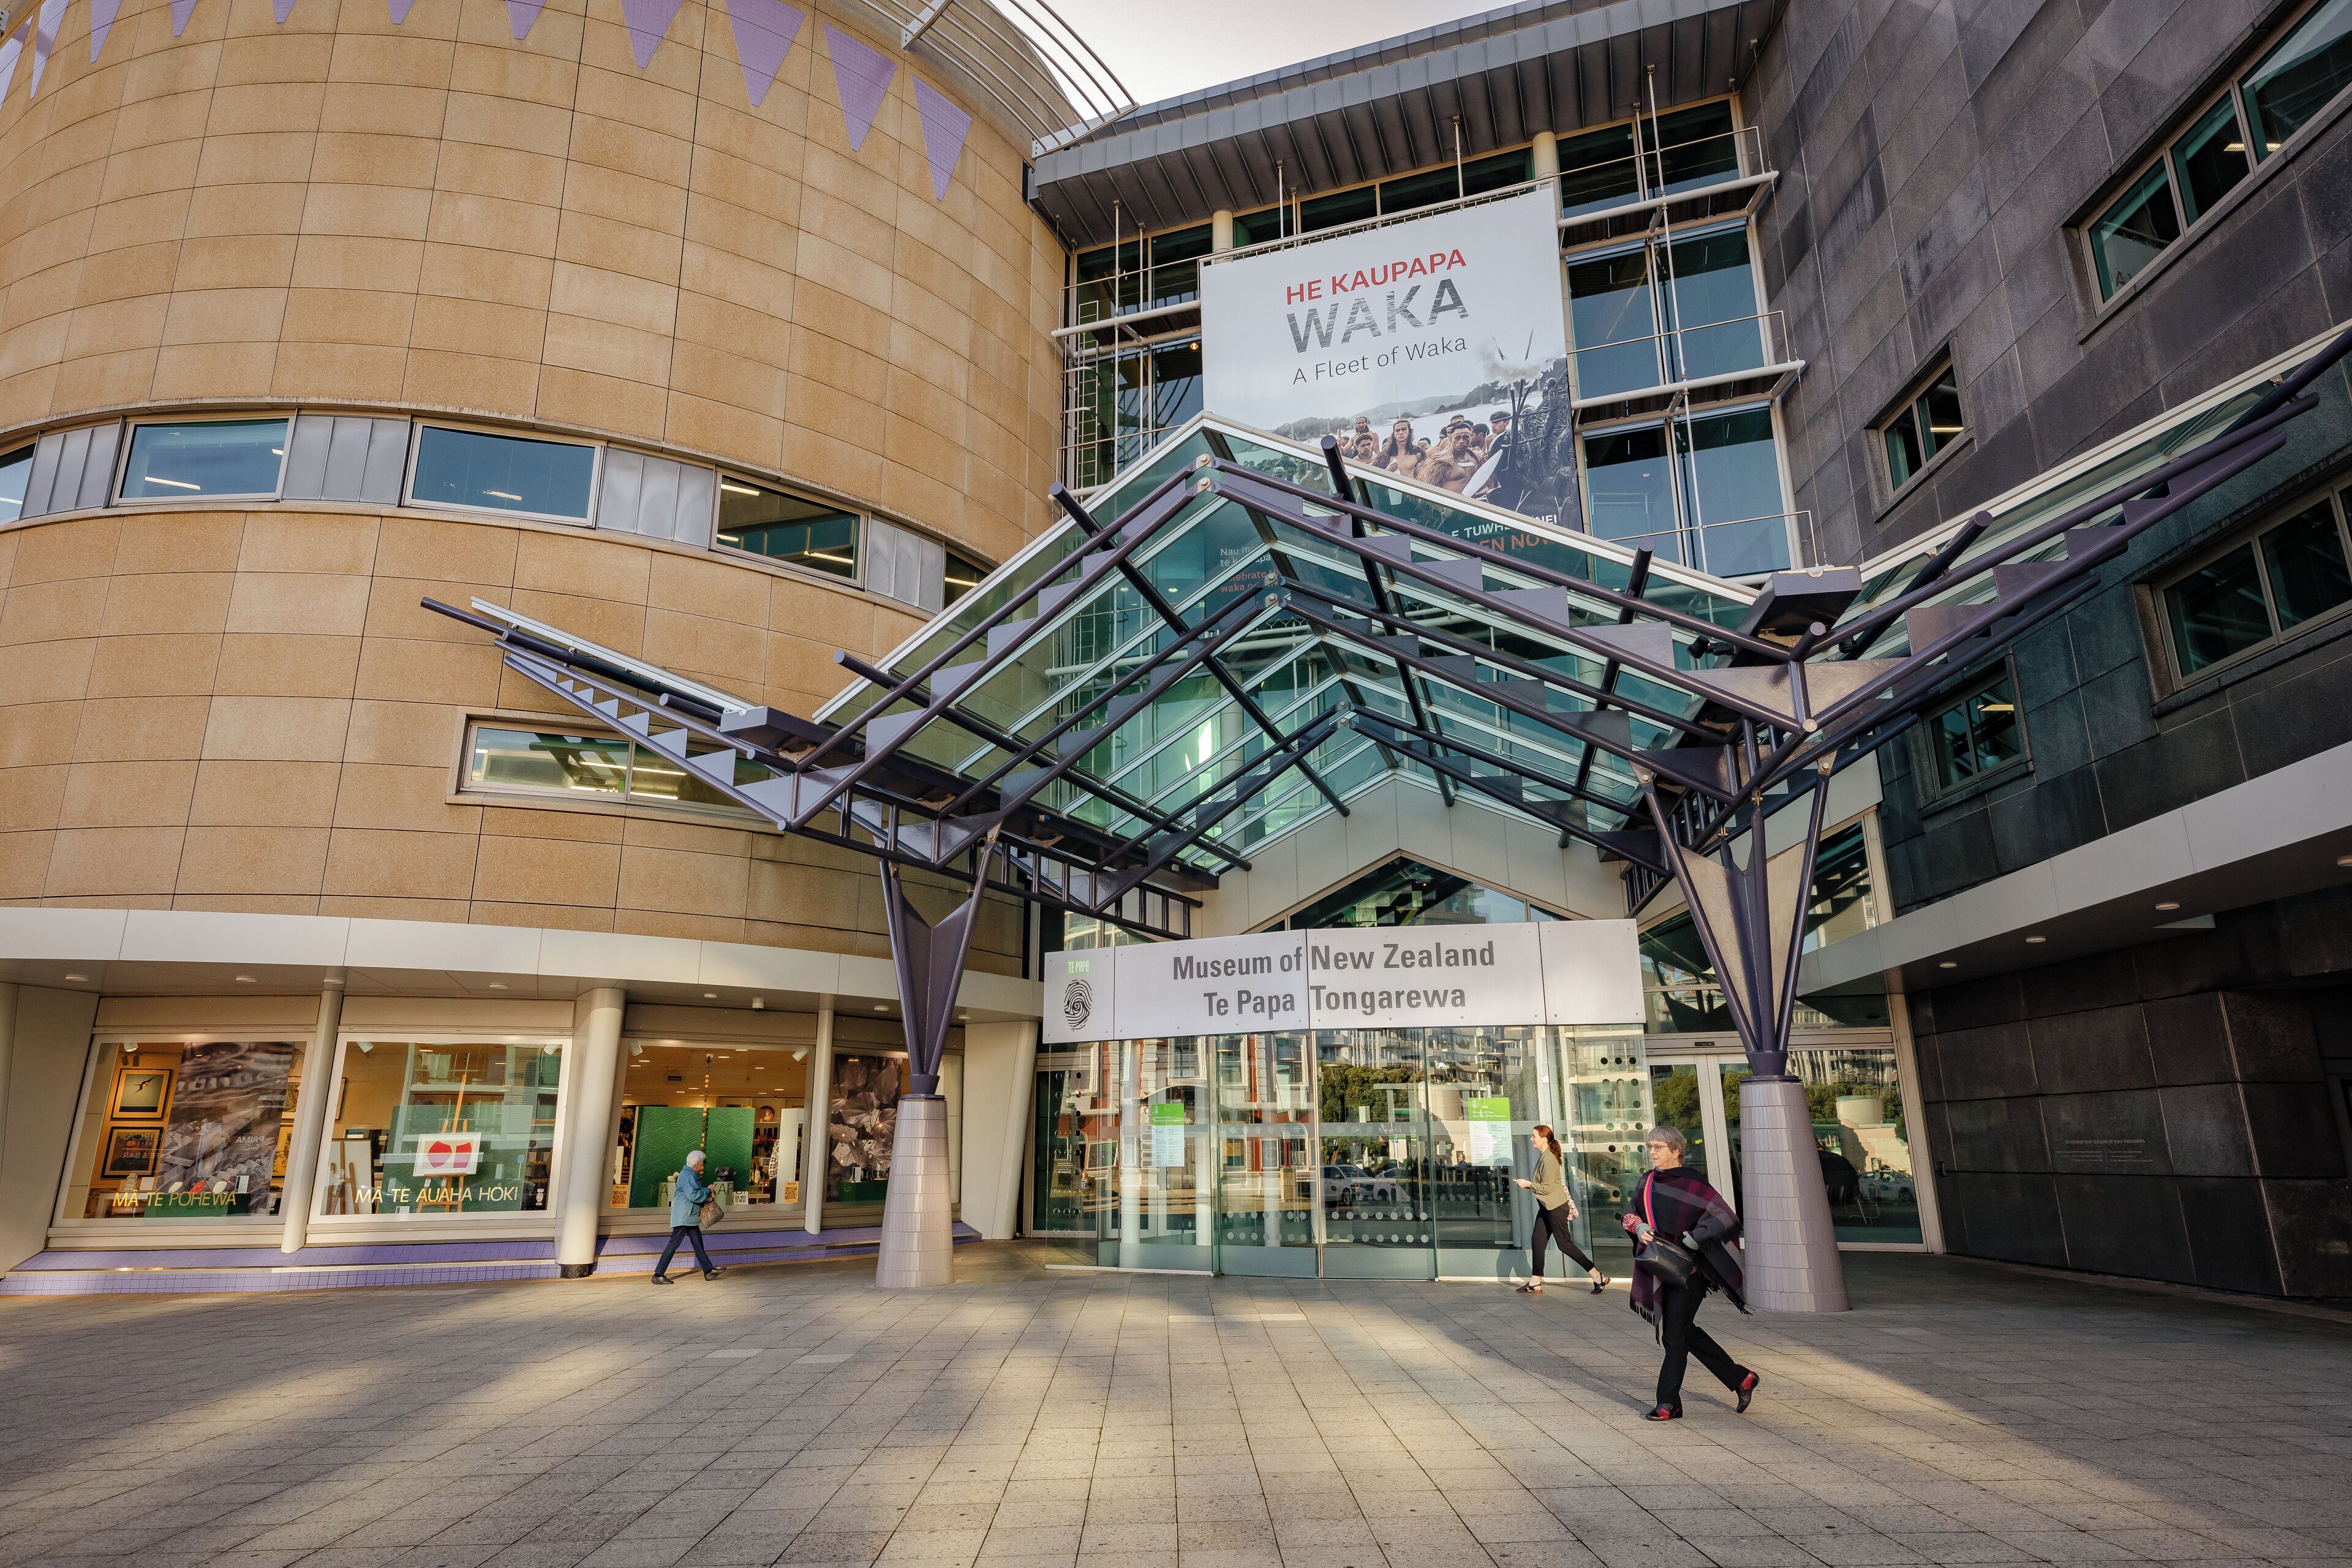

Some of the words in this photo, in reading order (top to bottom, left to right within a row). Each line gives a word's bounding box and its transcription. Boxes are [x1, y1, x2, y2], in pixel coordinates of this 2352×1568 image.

[1286, 279, 1322, 305] HE
[1332, 249, 1467, 295] KAUPAPA
[1286, 278, 1469, 353] WAKA
[1293, 368, 1307, 385] A
[1316, 356, 1370, 380] Fleet
[1378, 346, 1399, 367] of
[1406, 337, 1467, 361] Waka
[1511, 533, 1549, 550] NO
[1221, 583, 1245, 593] waka
[1068, 962, 1075, 973] TE
[1076, 960, 1089, 973] PAPA
[1173, 953, 1272, 981] Museum
[1280, 946, 1303, 972] of
[1311, 945, 1374, 970] New
[1383, 941, 1494, 969] Zealand
[1204, 992, 1229, 1017] Te
[1237, 990, 1295, 1020] Papa
[1310, 985, 1466, 1016] Tongarewa
[146, 1192, 164, 1207] TE
[168, 1191, 236, 1207] POHEWA
[391, 1188, 410, 1203] TE
[415, 1187, 472, 1202] AUAHA
[478, 1186, 518, 1202] HOKI
